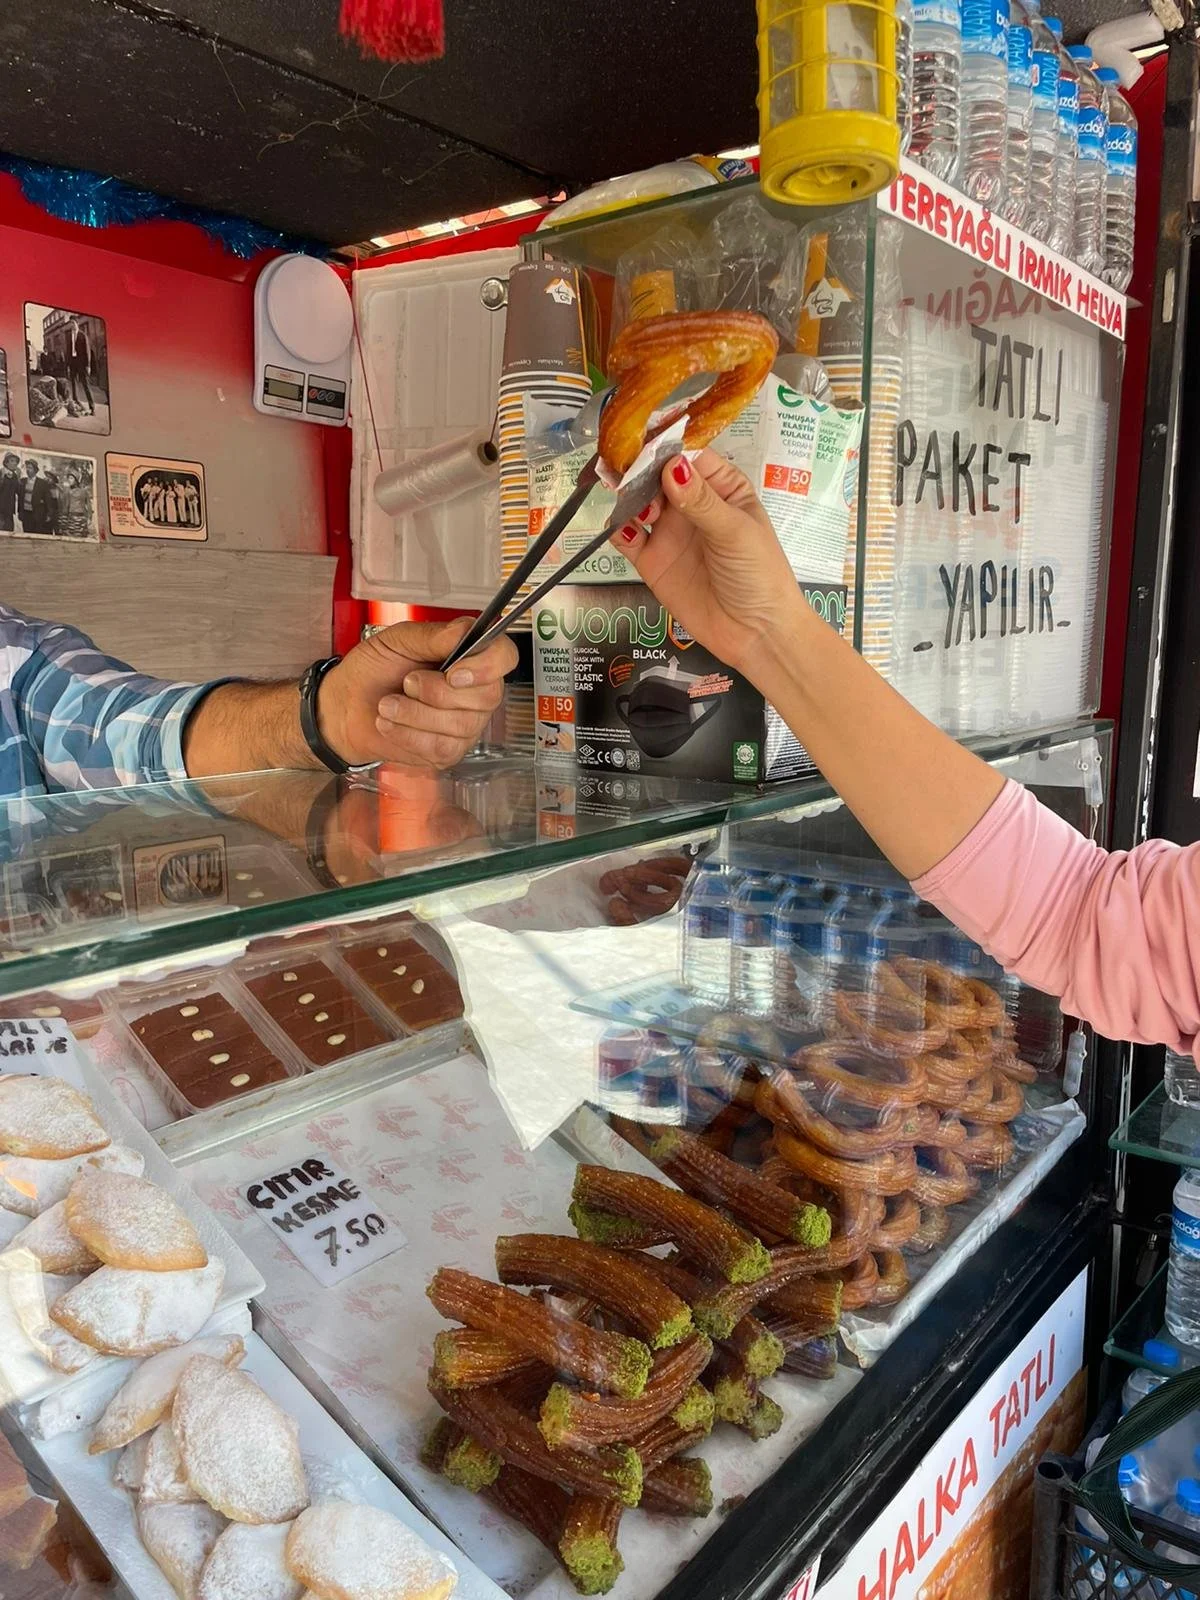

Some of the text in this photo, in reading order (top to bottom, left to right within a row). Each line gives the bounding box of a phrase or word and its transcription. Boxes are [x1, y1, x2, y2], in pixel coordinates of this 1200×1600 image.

[889, 170, 1124, 336] TEREYAĞLI İRMİK HELVA
[971, 324, 1063, 426] TATLI
[772, 466, 809, 483] 3 50
[896, 419, 1031, 524] PAKET
[536, 607, 667, 648] evony
[573, 664, 592, 672] SOFT
[632, 649, 667, 659] BLACK
[574, 673, 604, 682] ELASTIC
[574, 683, 594, 691] EARS
[542, 697, 573, 712] 3 50
[314, 1213, 386, 1268] 7.50
[856, 1333, 1056, 1600] HALKA TATLI
